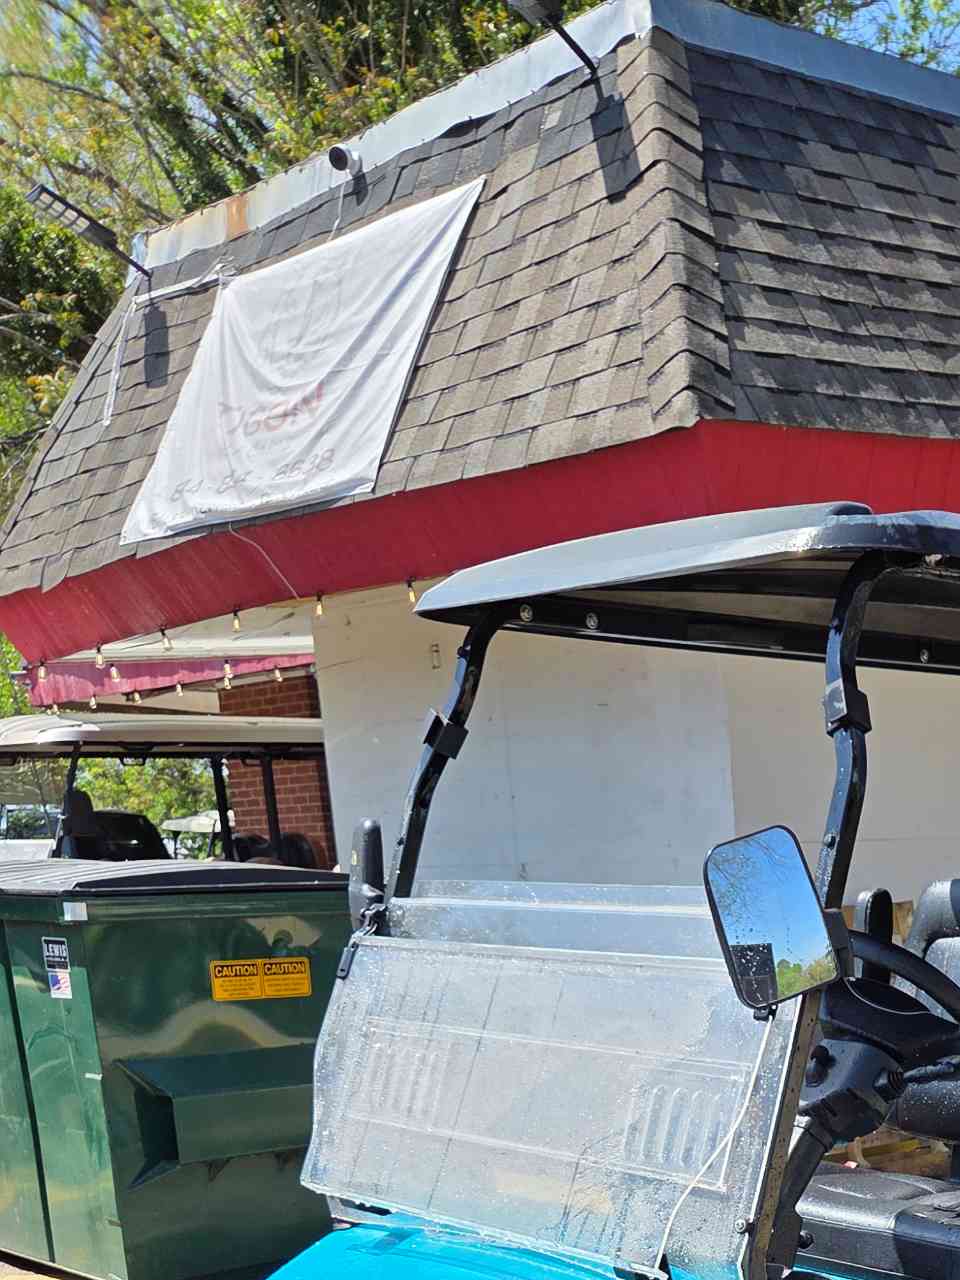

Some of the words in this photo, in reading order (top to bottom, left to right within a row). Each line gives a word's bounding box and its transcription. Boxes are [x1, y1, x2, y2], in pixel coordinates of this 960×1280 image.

[44, 943, 67, 957] LEWIS
[215, 964, 257, 977] CAUTION
[264, 962, 305, 974] CAUTION
